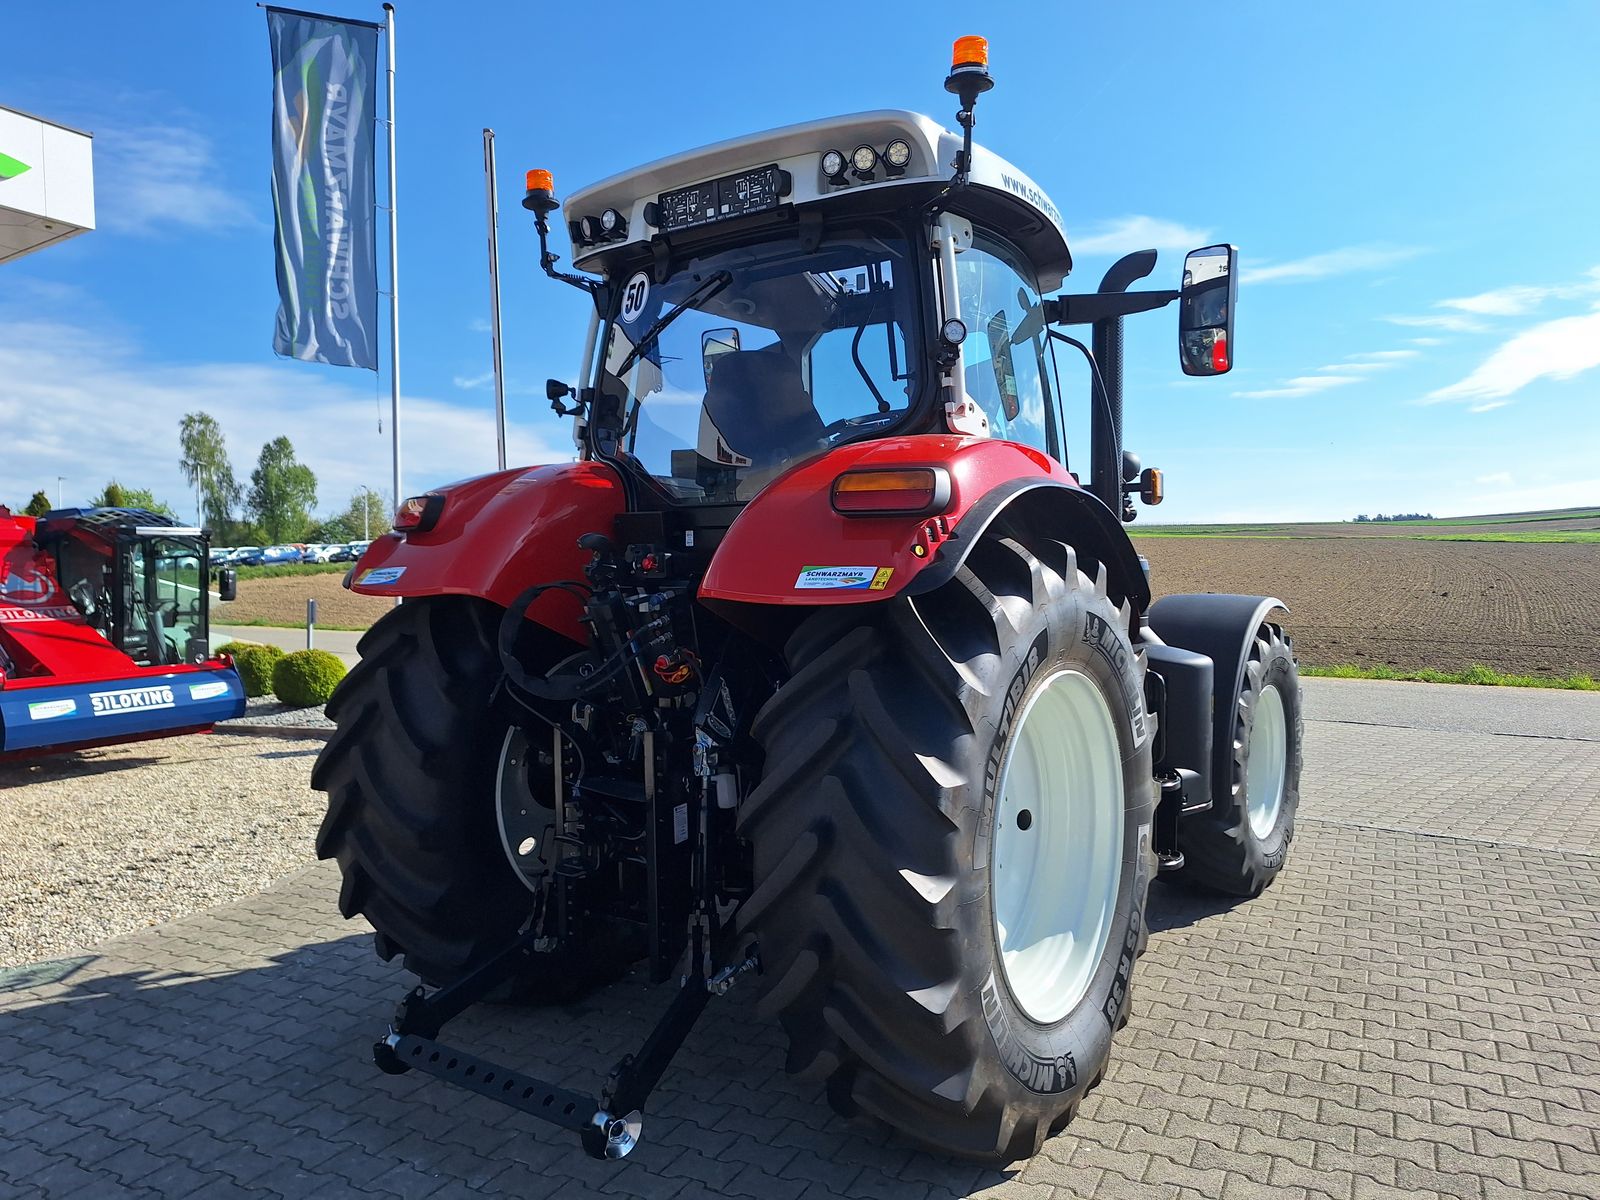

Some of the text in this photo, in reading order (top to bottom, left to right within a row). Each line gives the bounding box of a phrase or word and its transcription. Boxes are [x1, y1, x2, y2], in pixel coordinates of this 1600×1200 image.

[625, 280, 645, 314] 50
[91, 689, 174, 711] SILOKING
[979, 646, 1039, 836] MULTIBIB
[1106, 980, 1124, 1022] 38
[981, 985, 1054, 1092] MICHELIN
